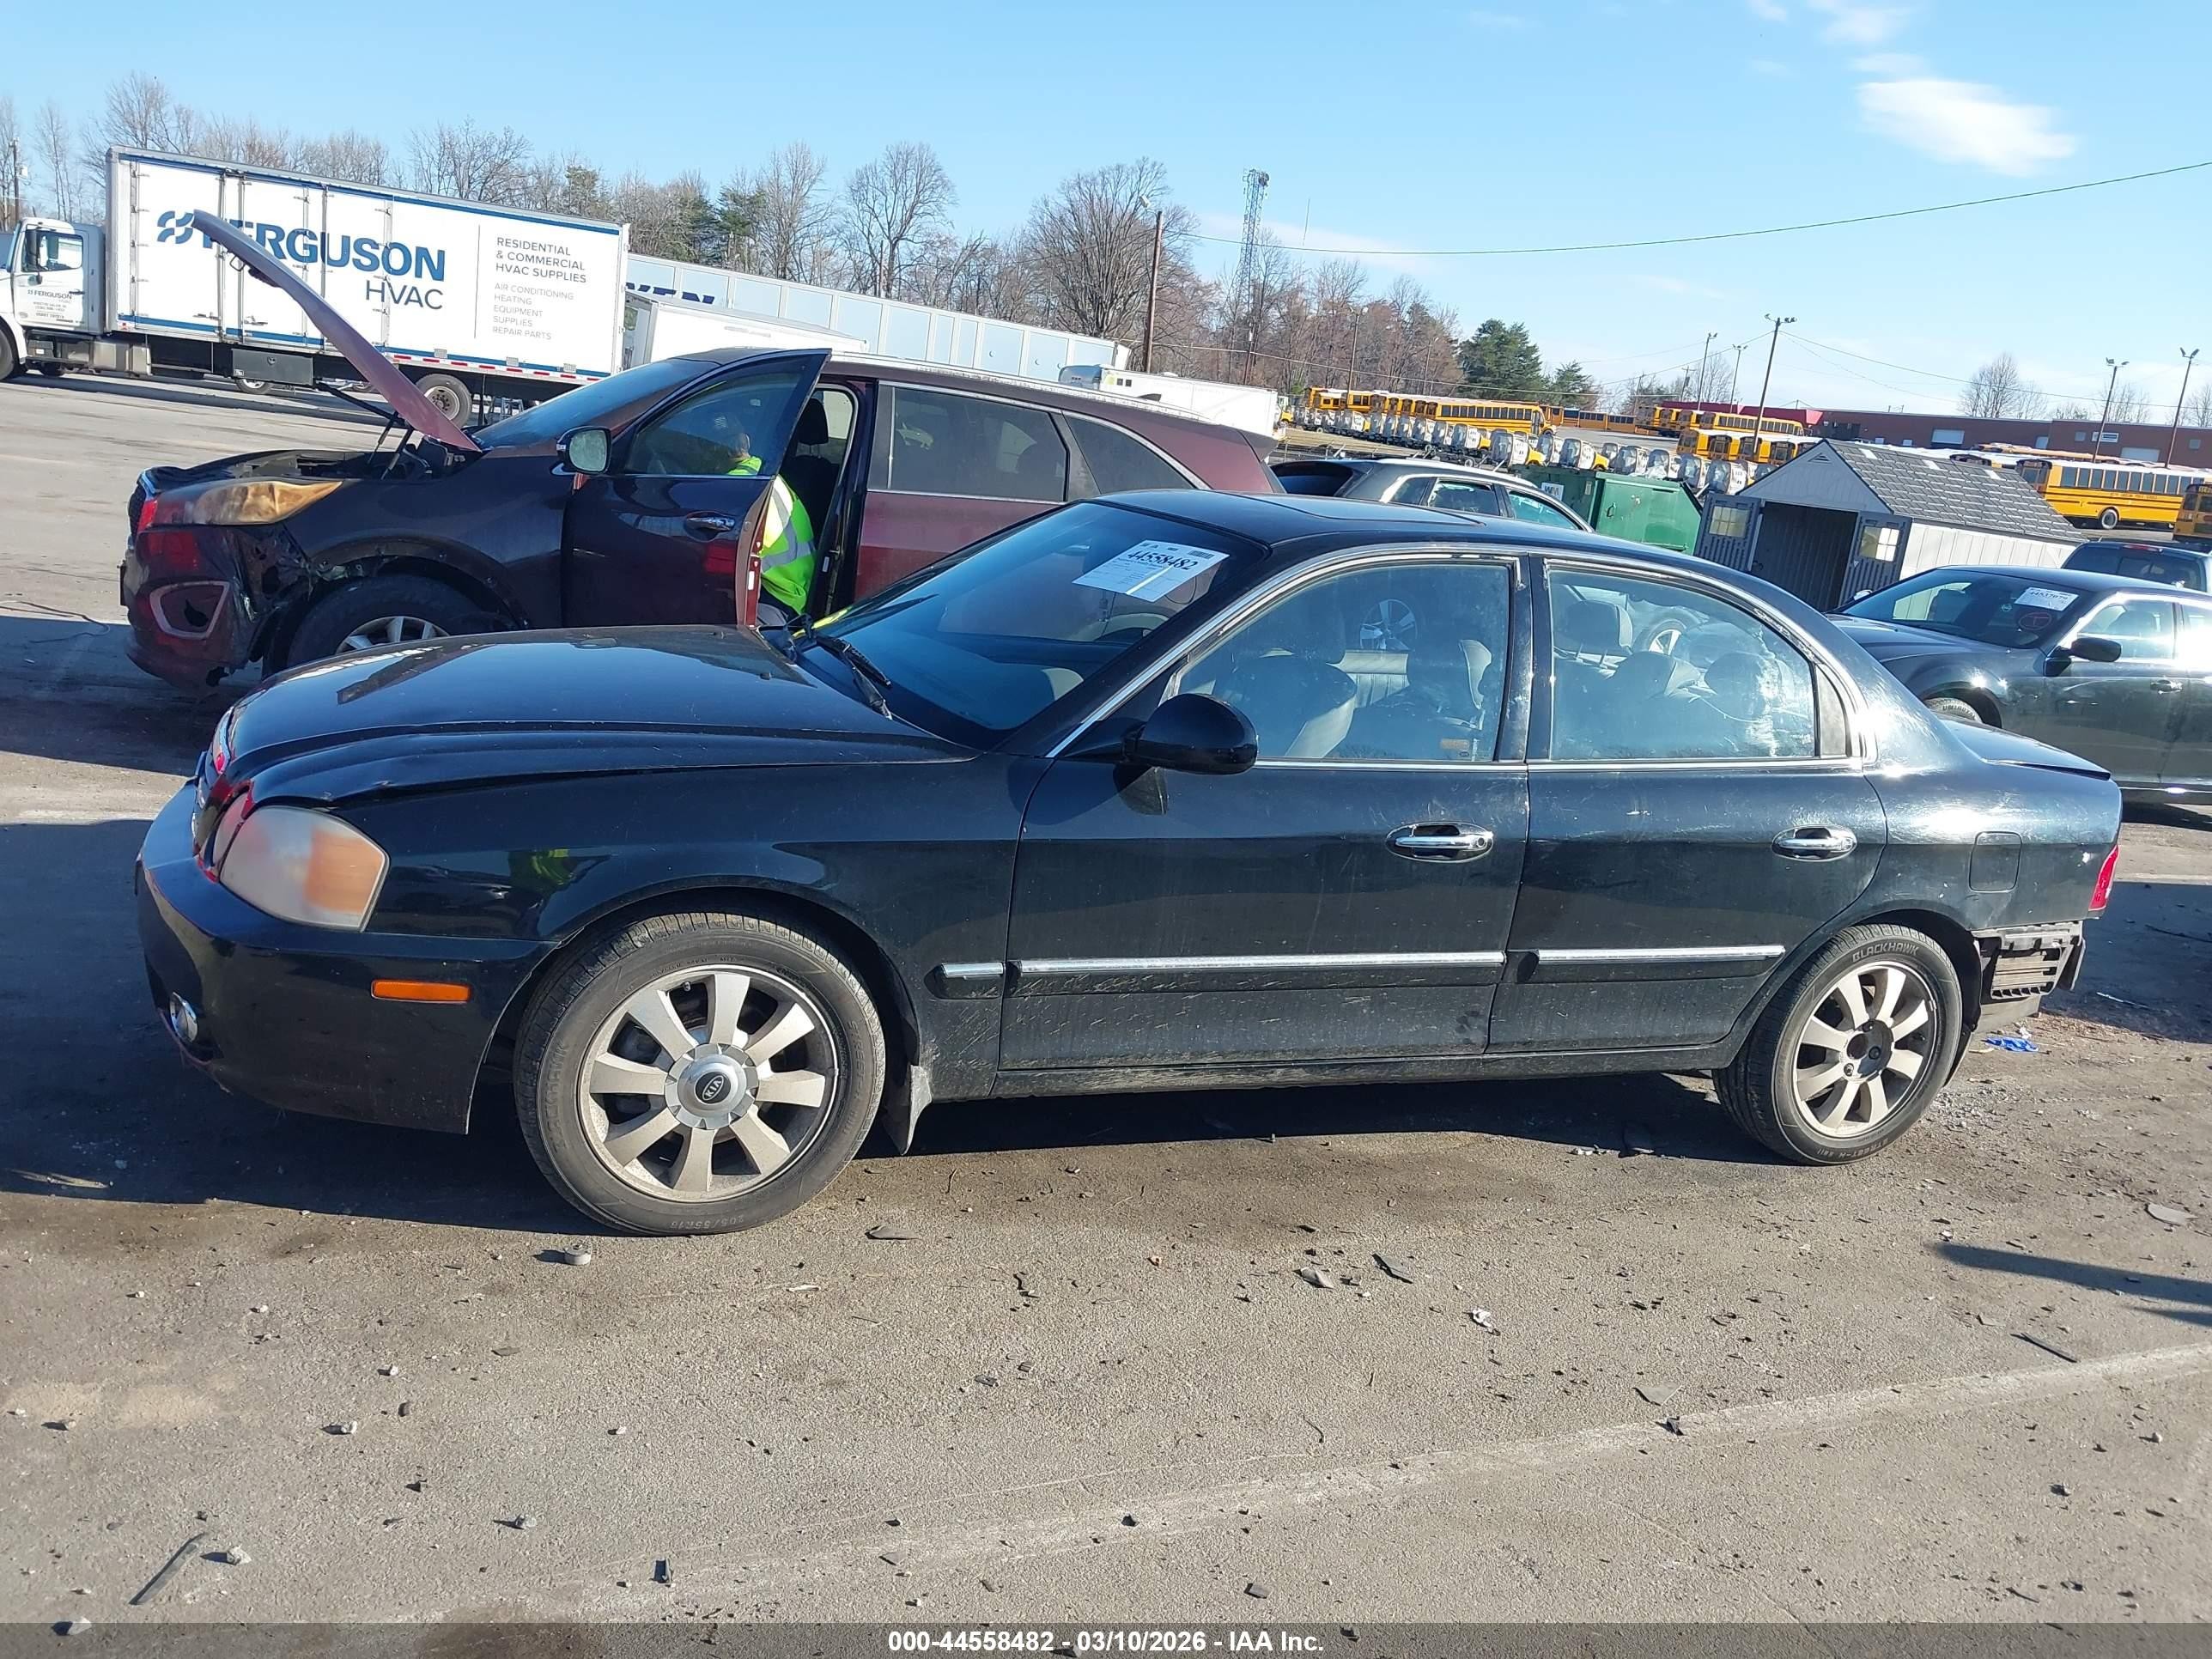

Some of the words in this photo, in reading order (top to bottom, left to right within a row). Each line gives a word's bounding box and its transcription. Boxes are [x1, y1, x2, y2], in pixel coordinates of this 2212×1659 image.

[203, 217, 446, 283] RGUSON
[496, 236, 571, 256] RESIDENTIAL
[495, 250, 504, 259] &
[507, 251, 586, 270] COMMERCIAL
[495, 263, 530, 276] HVAC
[532, 267, 586, 283] SUPPLIES
[34, 289, 72, 300] FERGUSON
[365, 279, 444, 310] HVAC
[494, 293, 532, 306] HEATING
[495, 283, 508, 292] AIR
[510, 284, 574, 301] CONDITIONING
[494, 304, 543, 318] EQUIPMENT
[492, 315, 533, 327] SUPPLIES
[492, 325, 523, 337] REPAIR
[525, 329, 552, 341] PARTS
[1127, 550, 1199, 571] 44558482
[1852, 942, 1920, 963] BLACKHAWK
[705, 1079, 722, 1097] KIA
